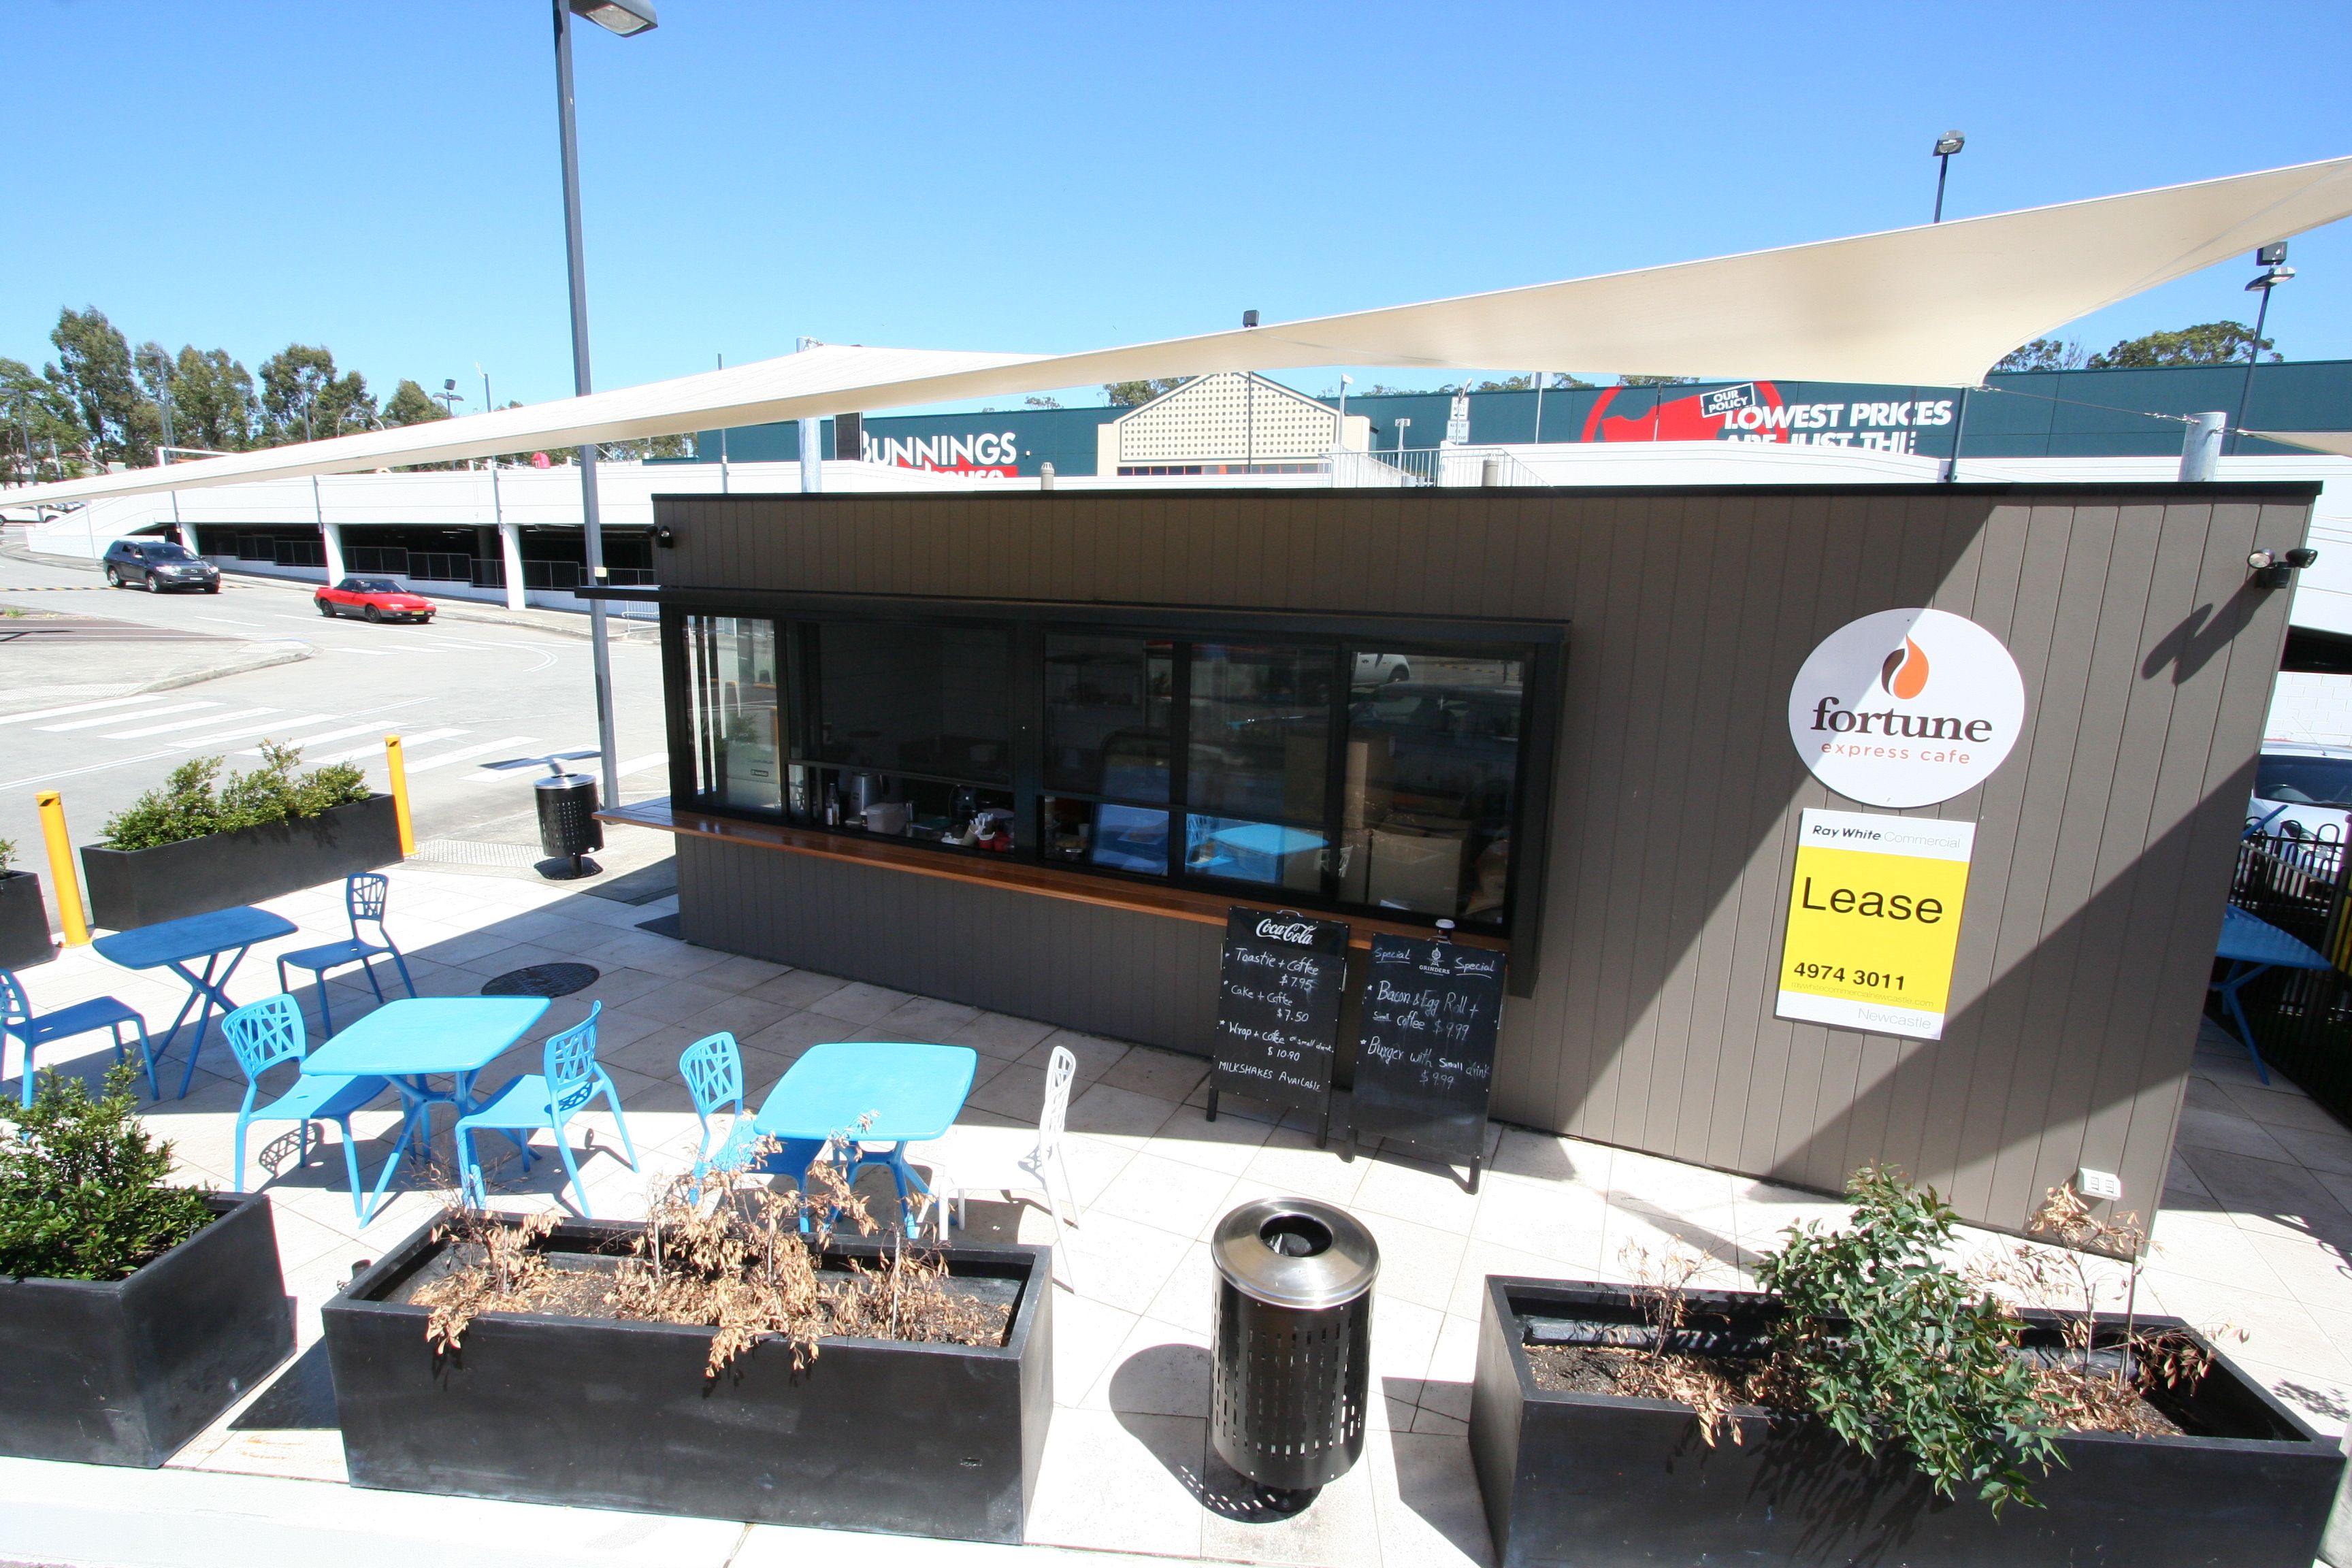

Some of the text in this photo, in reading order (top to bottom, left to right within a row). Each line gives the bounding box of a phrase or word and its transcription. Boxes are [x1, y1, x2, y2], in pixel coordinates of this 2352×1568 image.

[1709, 396, 1748, 413] POLICY
[1714, 390, 1739, 402] OUR
[1724, 400, 1953, 430] LOWEST PRICES
[1810, 696, 1993, 742] fortune
[1821, 742, 1970, 764] express cafe
[1812, 825, 1961, 849] Ray White Commercial
[1802, 877, 1943, 924] Lease
[1256, 918, 1318, 945] Coca-Cola
[1235, 947, 1276, 967] Toastie
[1287, 956, 1319, 975] Coffee
[1374, 949, 1410, 961] Special
[1454, 957, 1494, 973] Special
[1419, 964, 1450, 975] GRINDERS
[1793, 962, 1904, 991] 4974 3011
[1231, 985, 1254, 998] Cake
[1377, 980, 1411, 1004] Bacon
[1858, 1008, 1931, 1029] Newcastle
[1229, 1022, 1252, 1041] Wrap
[1367, 1036, 1405, 1066] Burger
[1410, 1049, 1433, 1068] with
[1465, 1061, 1491, 1079] drink
[1218, 1061, 1273, 1079] MILKSHAKES
